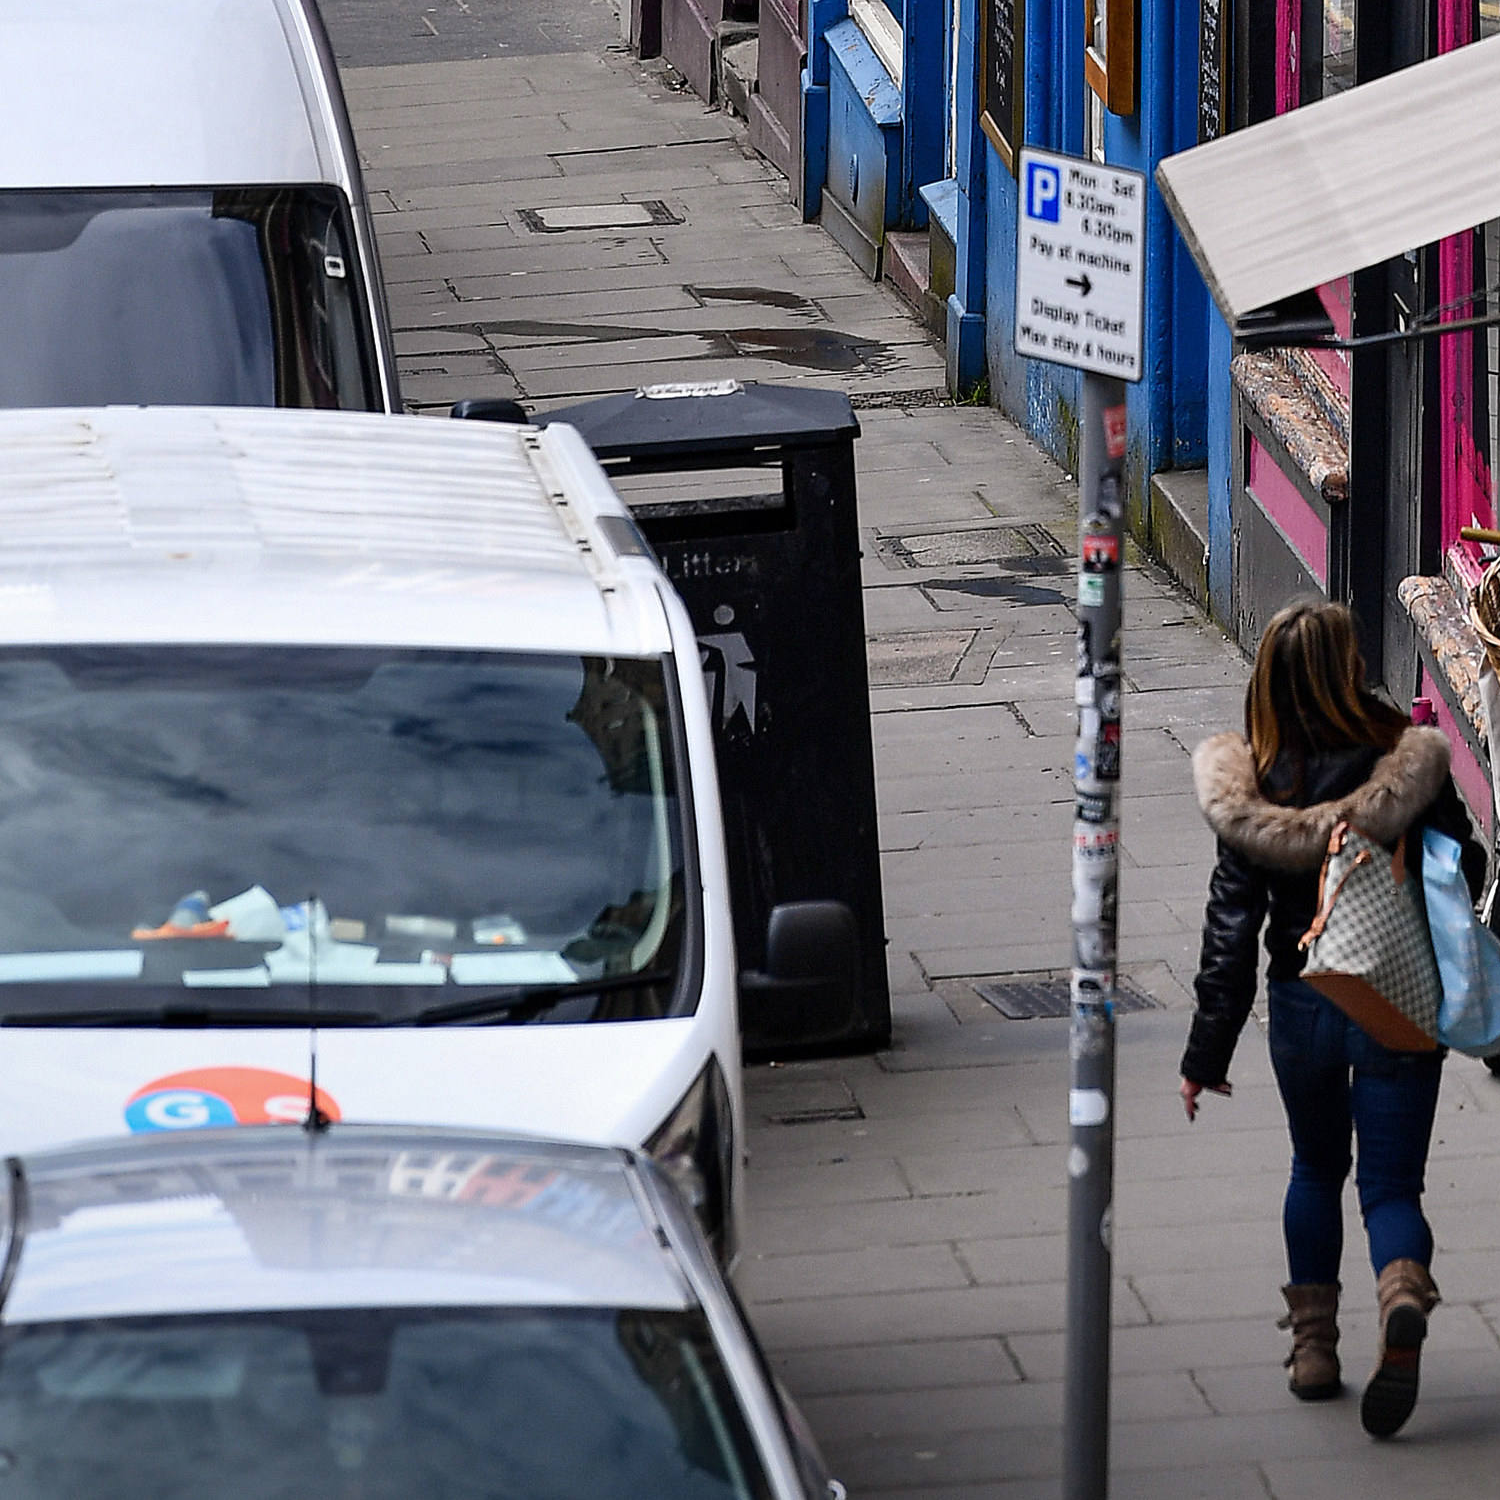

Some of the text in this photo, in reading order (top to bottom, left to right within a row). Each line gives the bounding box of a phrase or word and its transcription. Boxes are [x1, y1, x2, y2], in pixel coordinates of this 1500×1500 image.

[1069, 168, 1096, 189] Mon
[1112, 179, 1136, 199] Sat
[1030, 236, 1131, 273] Pay at machine
[1031, 298, 1125, 336] Display Ticket
[1021, 325, 1047, 346] Max
[1053, 336, 1079, 355] stay
[1097, 344, 1135, 369] hours
